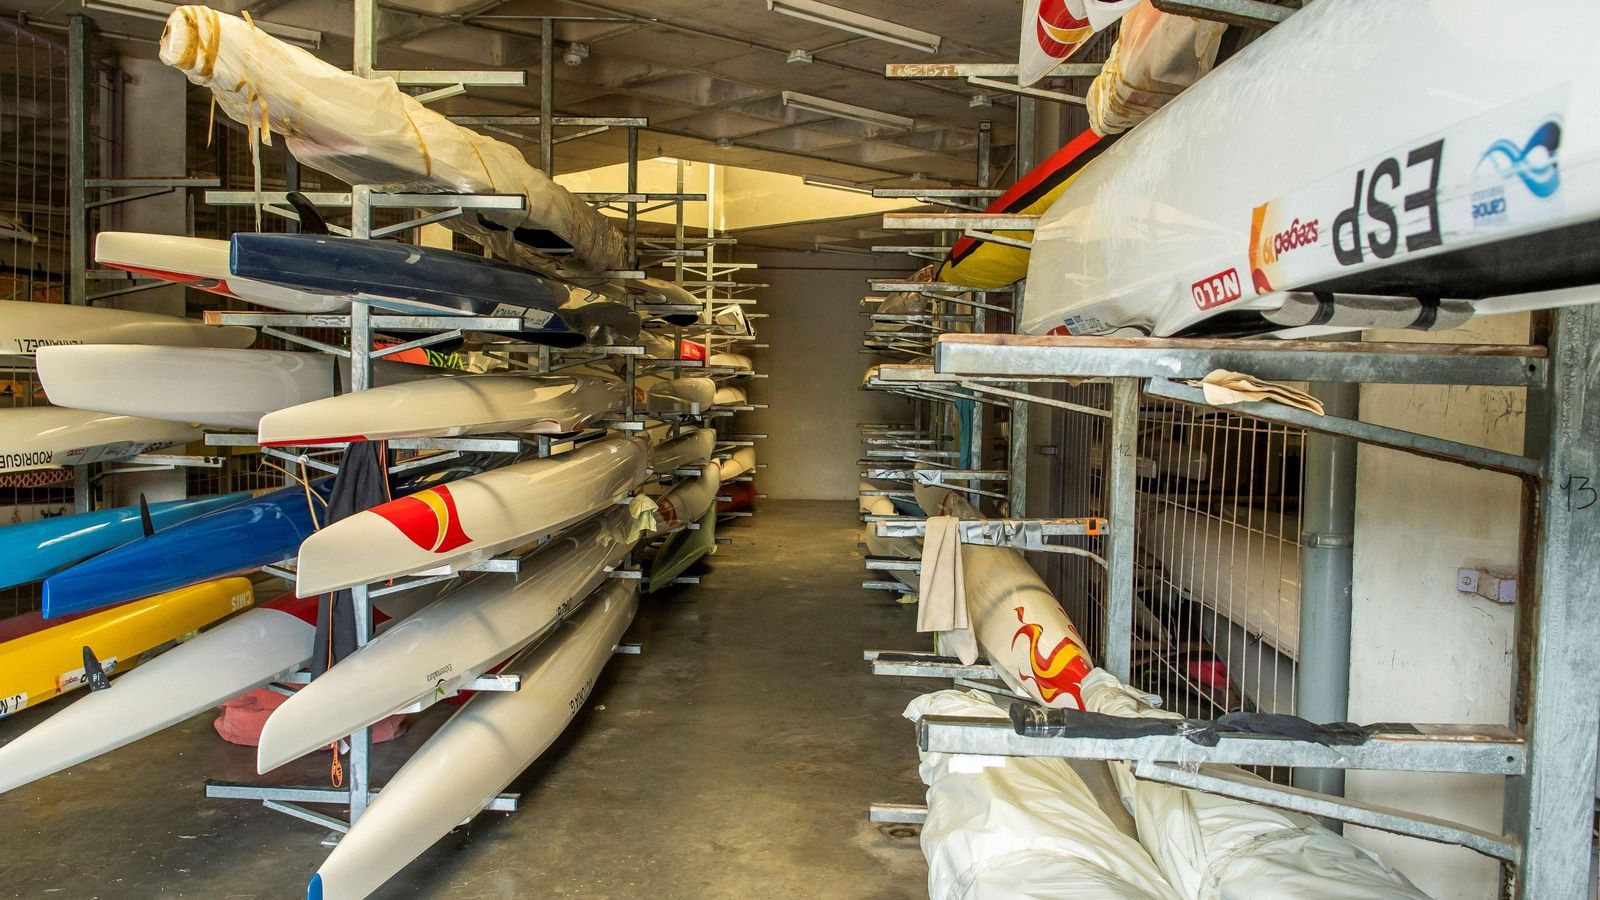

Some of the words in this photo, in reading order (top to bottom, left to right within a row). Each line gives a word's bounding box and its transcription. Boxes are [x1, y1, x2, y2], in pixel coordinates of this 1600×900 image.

[1332, 138, 1445, 267] ESP
[1193, 271, 1240, 307] NELO
[1559, 474, 1598, 512] 13
